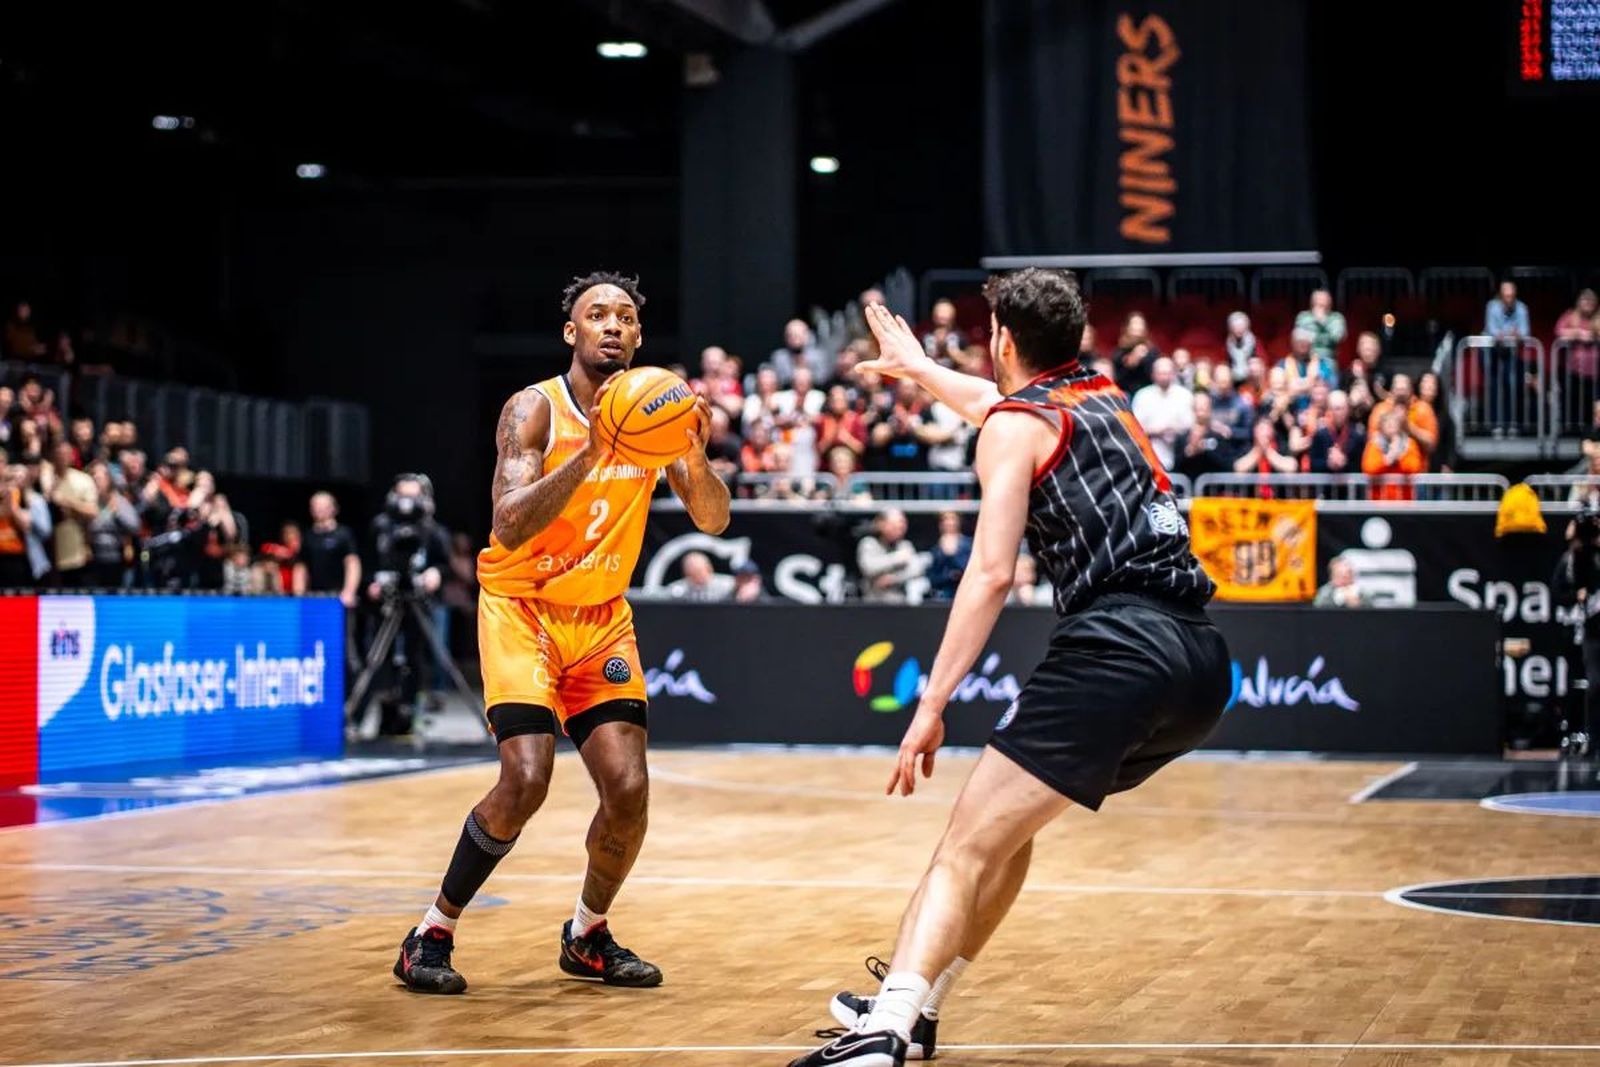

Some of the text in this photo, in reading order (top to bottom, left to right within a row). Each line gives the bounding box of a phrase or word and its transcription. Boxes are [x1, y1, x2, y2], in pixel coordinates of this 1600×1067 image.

[1116, 13, 1182, 243] NINERS
[584, 498, 610, 541] 2
[50, 622, 81, 658] eins
